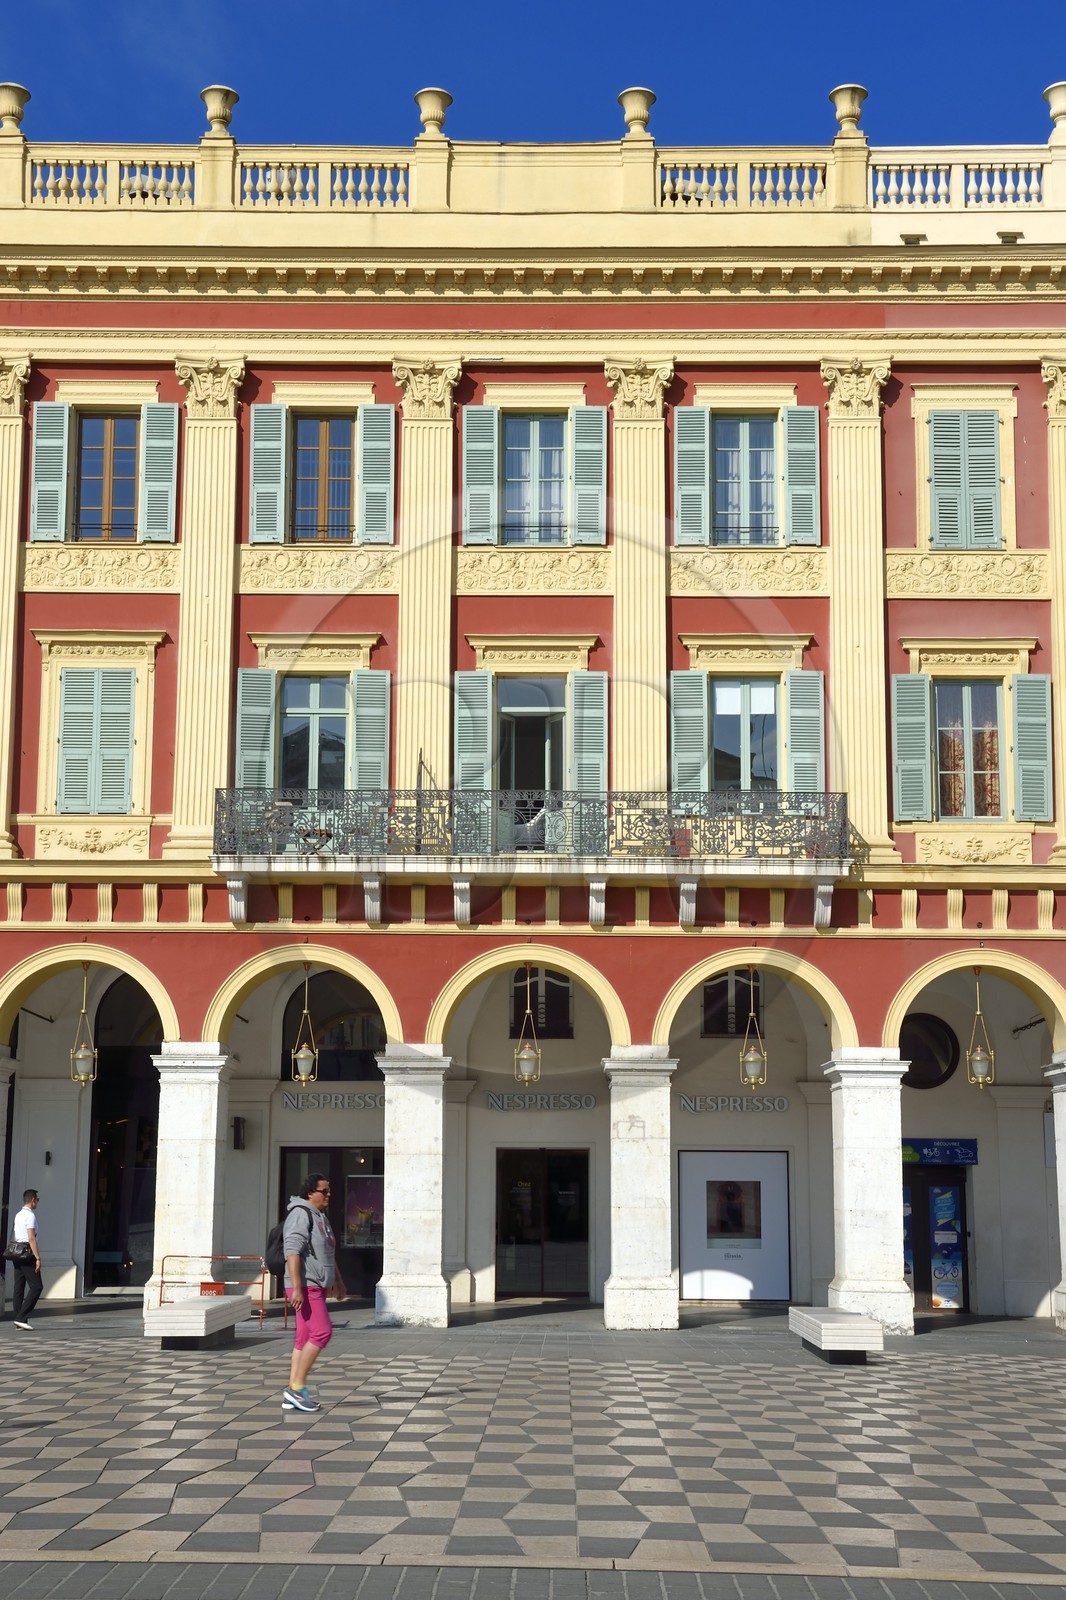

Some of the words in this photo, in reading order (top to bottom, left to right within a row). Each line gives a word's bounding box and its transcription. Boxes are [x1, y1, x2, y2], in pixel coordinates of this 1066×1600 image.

[281, 1089, 386, 1112] NESPRESSO
[486, 1091, 597, 1112] NESPRESSO
[678, 1093, 790, 1114] NESPRESSO
